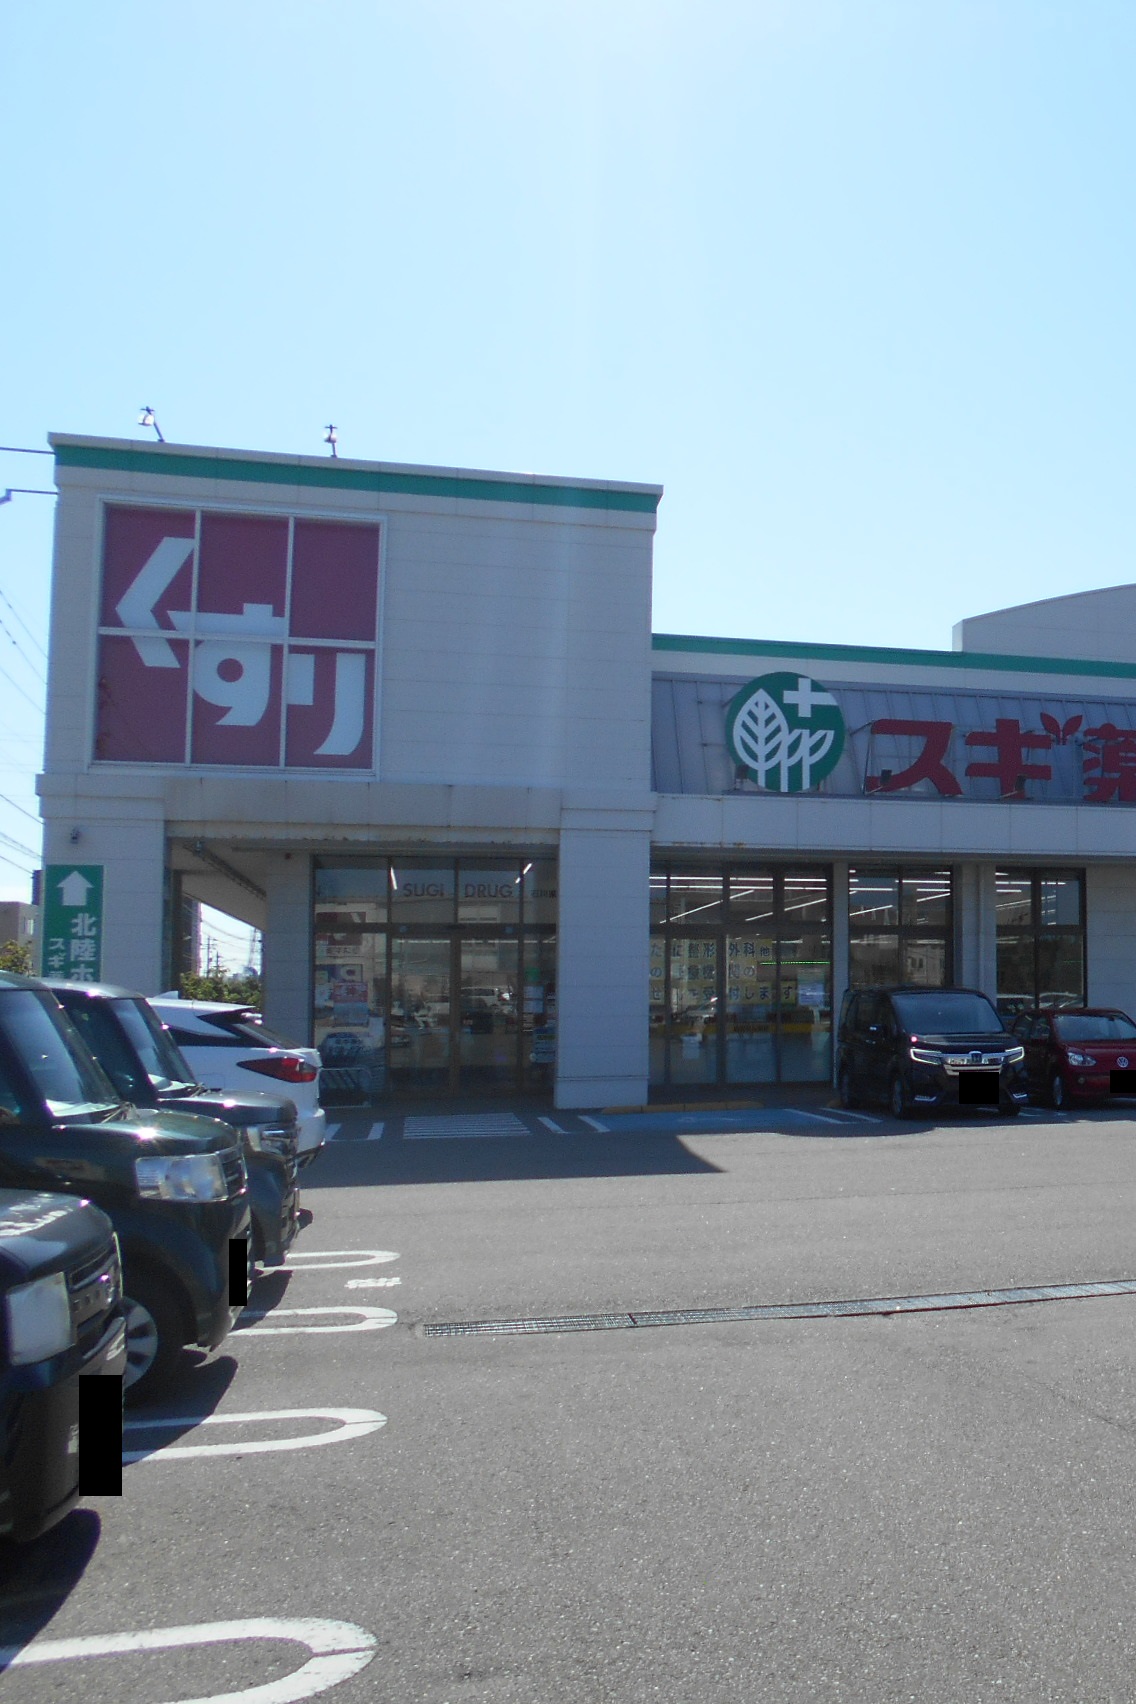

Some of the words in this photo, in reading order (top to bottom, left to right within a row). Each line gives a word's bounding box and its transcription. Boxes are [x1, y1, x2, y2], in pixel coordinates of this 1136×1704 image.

[115, 536, 366, 756] くすり
[465, 883, 513, 898] DRUG
